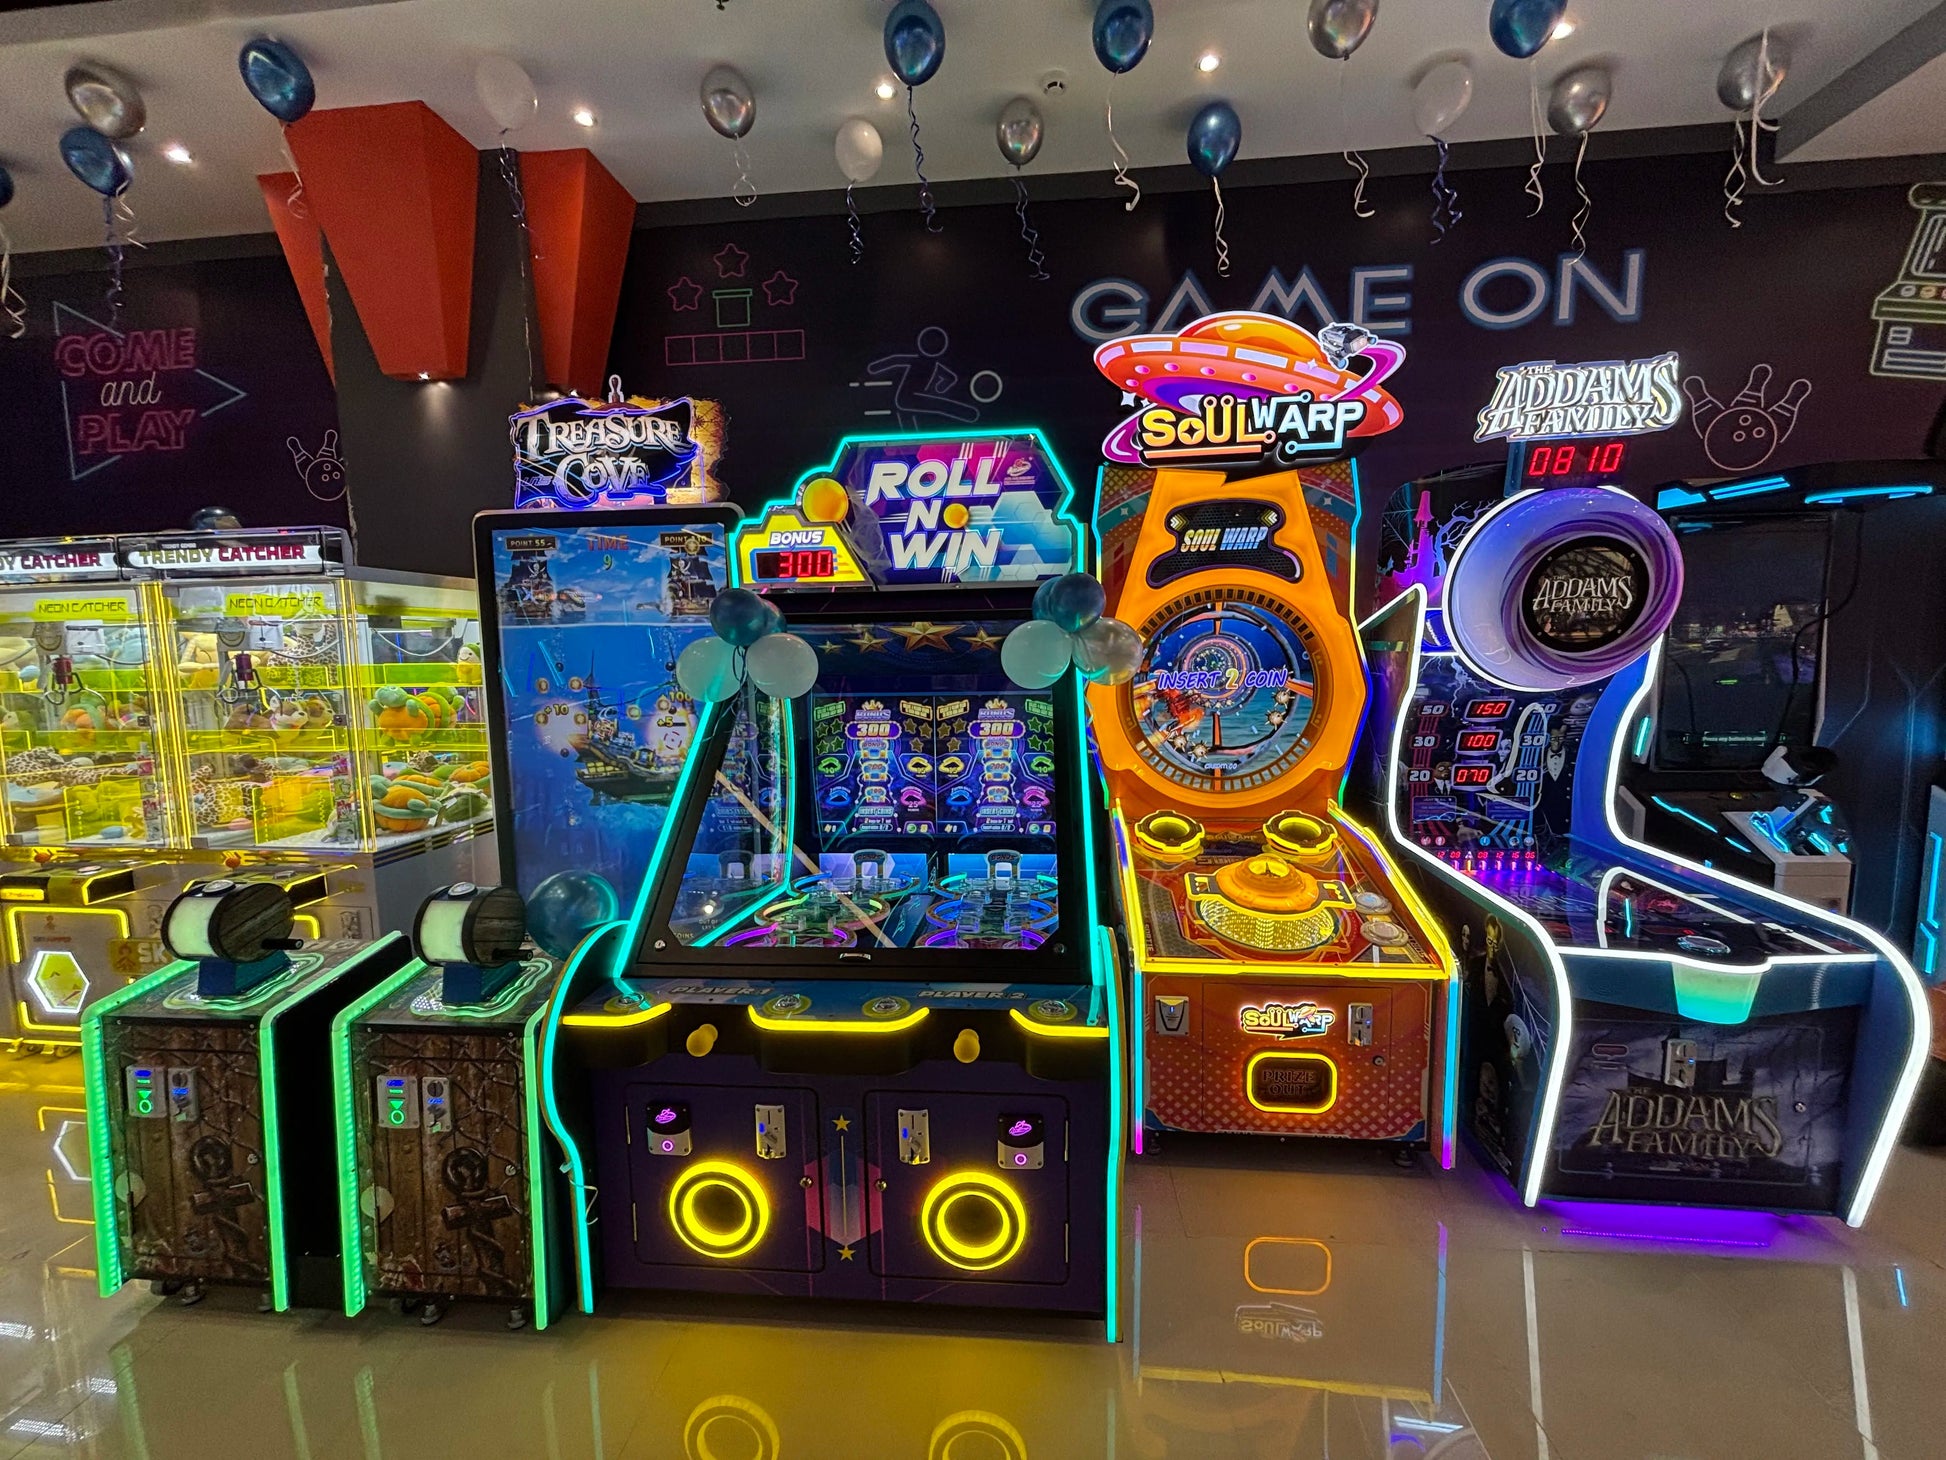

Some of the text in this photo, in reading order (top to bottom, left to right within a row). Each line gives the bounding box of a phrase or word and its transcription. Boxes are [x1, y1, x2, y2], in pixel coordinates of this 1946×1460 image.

[1071, 249, 1645, 342] GAME ON
[55, 327, 196, 377] COME
[100, 371, 162, 407] and
[1486, 356, 1682, 436] ADDAMS
[78, 408, 196, 455] PLAY
[1519, 404, 1654, 436] FAMILY
[516, 411, 690, 460] TREASURE
[555, 452, 650, 499] COVE
[866, 458, 1003, 506] ROLL
[904, 498, 941, 536] N
[769, 530, 824, 547] BONUS
[1180, 526, 1269, 553] SOUL WARP
[21, 551, 102, 570] CATCHER
[139, 544, 307, 565] TRENDY CATCHER
[890, 528, 1004, 575] WIN
[779, 550, 835, 579] 300
[1532, 575, 1633, 611] ADDAMS
[38, 603, 71, 614] NEON
[1157, 668, 1289, 691] INSERT 2 COIN
[1421, 704, 1445, 715] 50
[1476, 702, 1507, 715] 150
[856, 722, 891, 737] 300
[979, 722, 1015, 736] 300
[1521, 734, 1545, 746] 30
[1413, 735, 1436, 747] 30
[1467, 734, 1496, 748] 100
[1409, 769, 1431, 782] 20
[1516, 769, 1538, 781] 20
[671, 985, 753, 995] PLAYER
[918, 990, 1004, 999] PLAYER
[1588, 1090, 1783, 1158] ADDAMS
